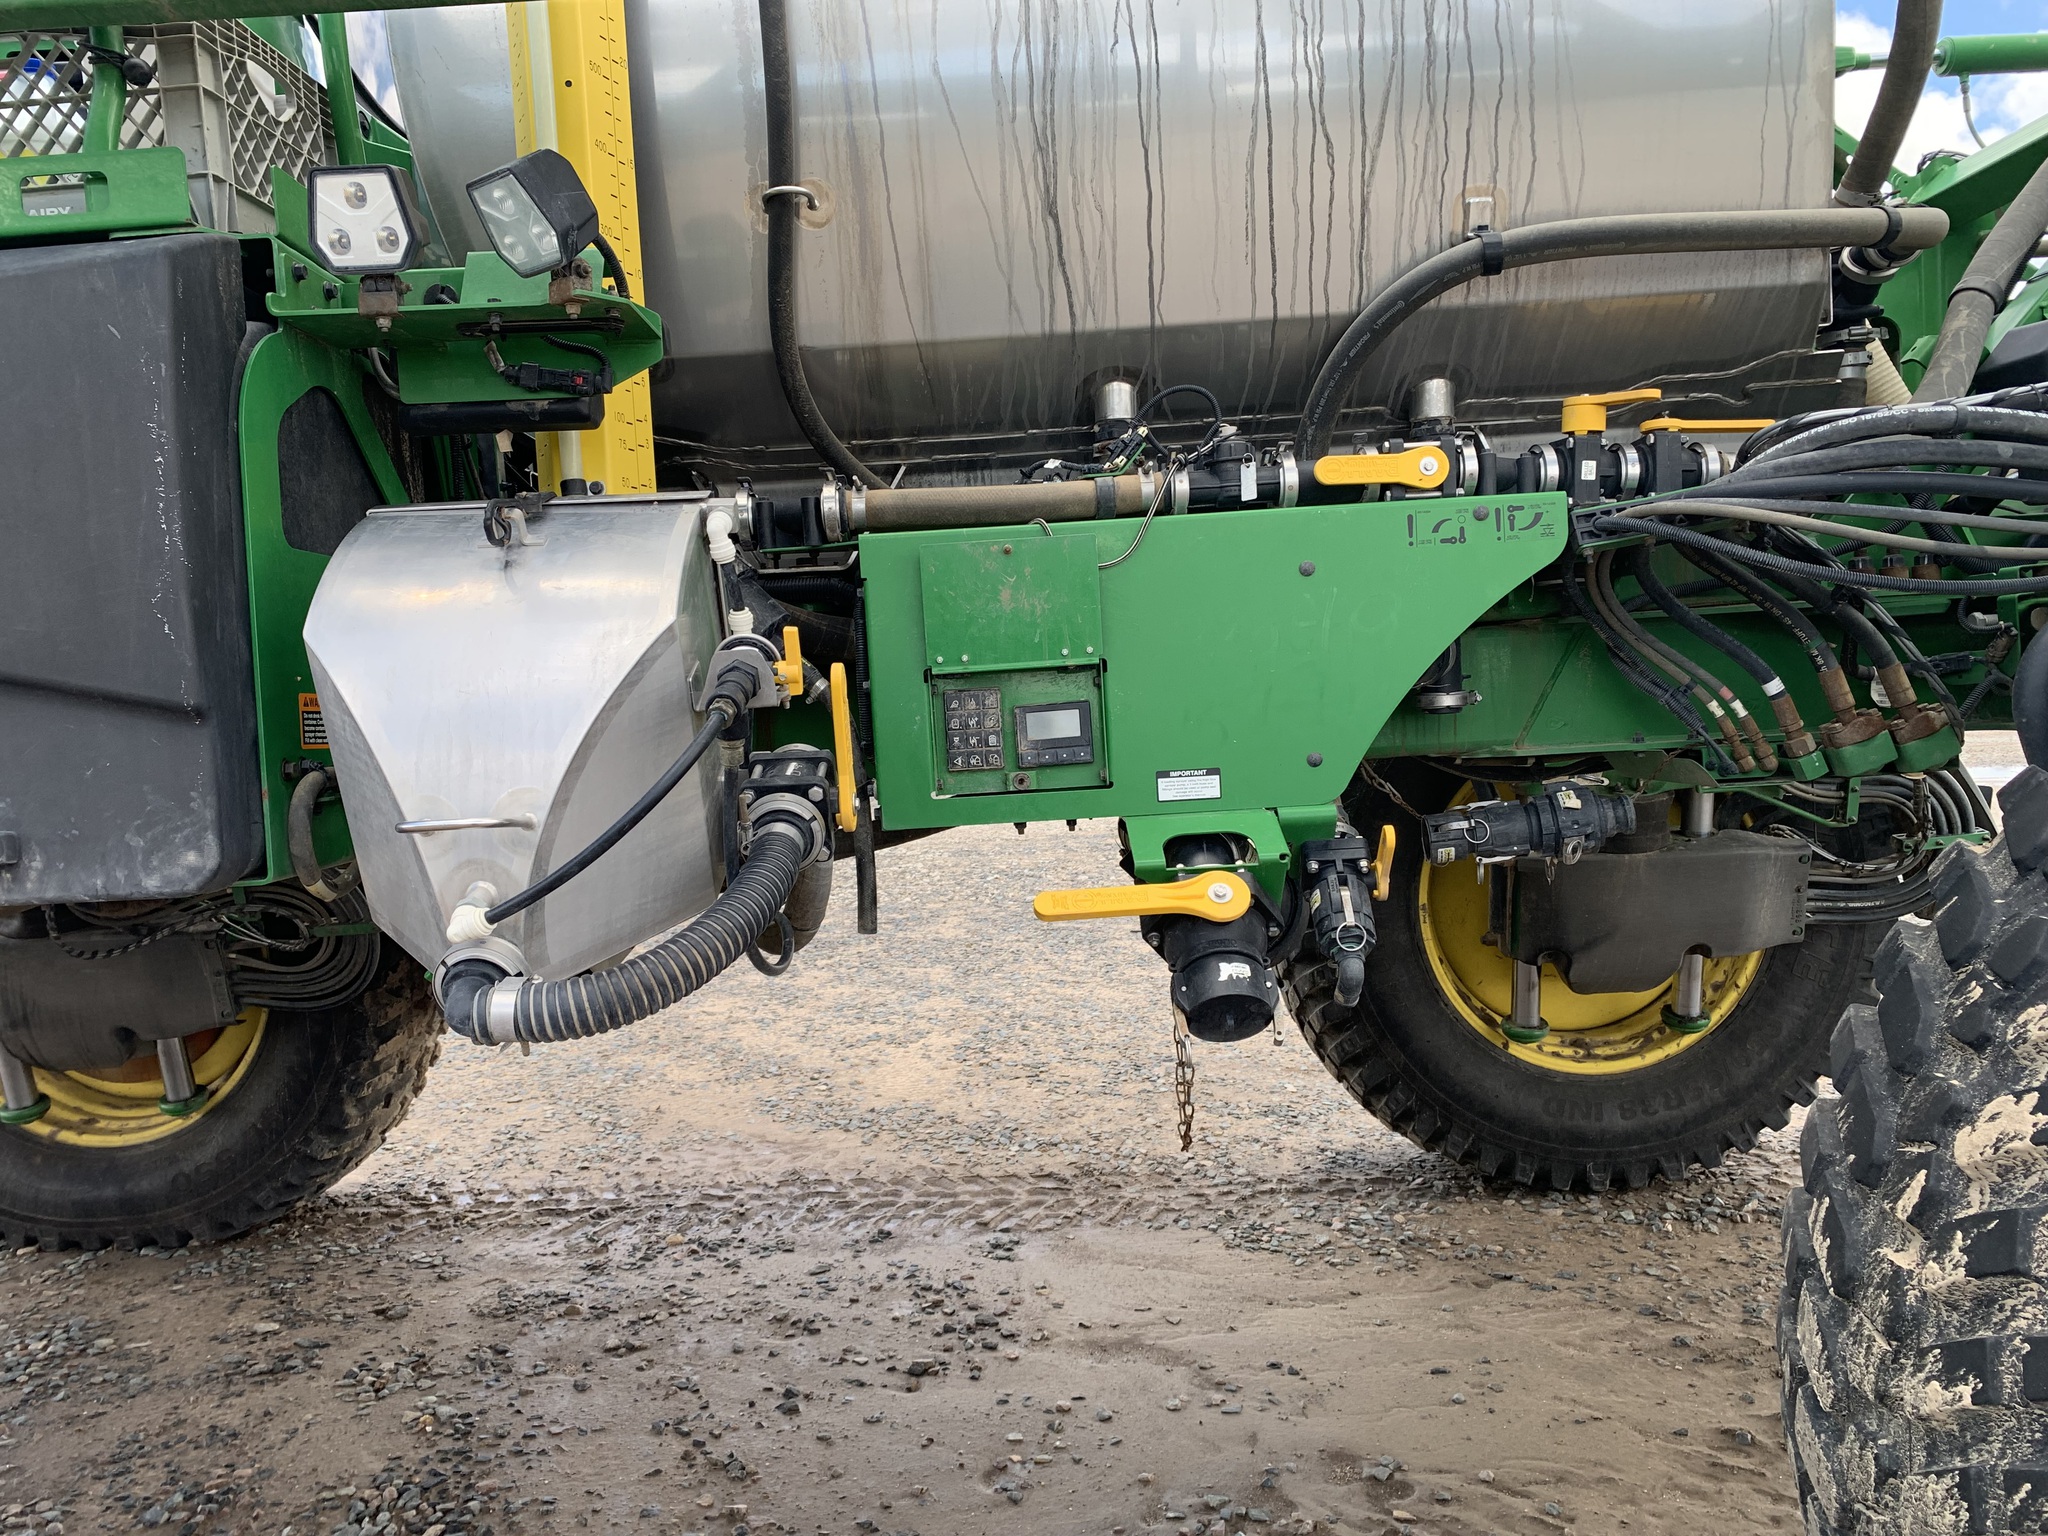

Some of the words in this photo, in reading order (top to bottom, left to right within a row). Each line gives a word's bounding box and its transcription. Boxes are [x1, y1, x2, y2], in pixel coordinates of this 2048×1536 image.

[590, 60, 601, 76] 500
[620, 56, 628, 70] 20
[594, 138, 607, 154] 400
[626, 158, 634, 170] 15
[600, 224, 612, 237] 300
[635, 268, 642, 279] 10
[1349, 332, 1370, 358] FRONTIER
[641, 377, 646, 387] 5
[614, 411, 626, 423] 100
[644, 414, 648, 422] 4
[1838, 416, 1858, 426] ISO
[619, 438, 627, 450] 75
[646, 438, 650, 449] 3
[622, 477, 630, 488] 50
[649, 478, 652, 488] 2
